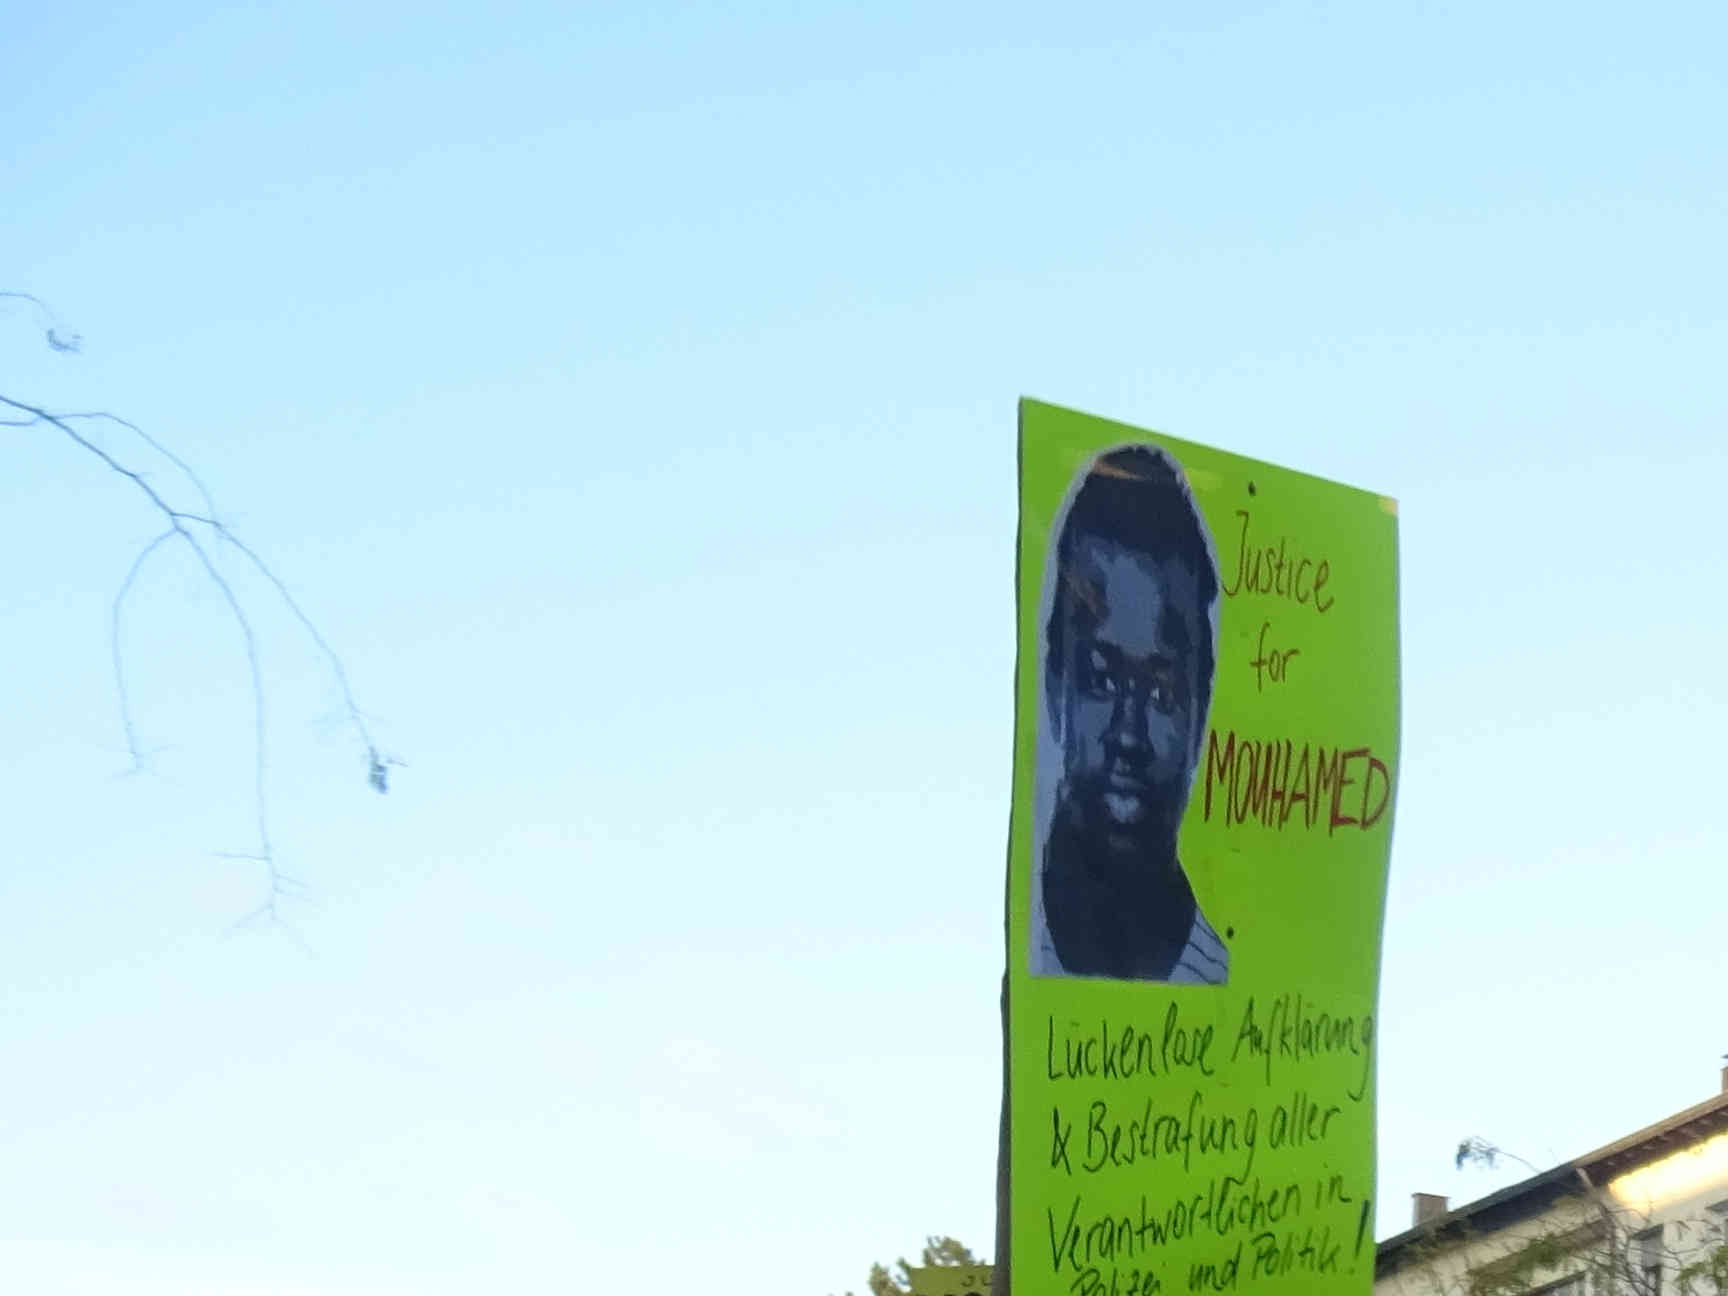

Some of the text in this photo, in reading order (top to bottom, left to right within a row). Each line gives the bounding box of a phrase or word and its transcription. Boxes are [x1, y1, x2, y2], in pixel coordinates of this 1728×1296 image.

[1222, 510, 1334, 613] Justice
[1249, 622, 1300, 693] for
[1204, 729, 1391, 838] MOUHAMED
[1083, 1090, 1257, 1185] Bestrafung
[1269, 1092, 1341, 1149] aller
[1316, 1174, 1351, 1209] in
[1189, 1241, 1242, 1292] und
